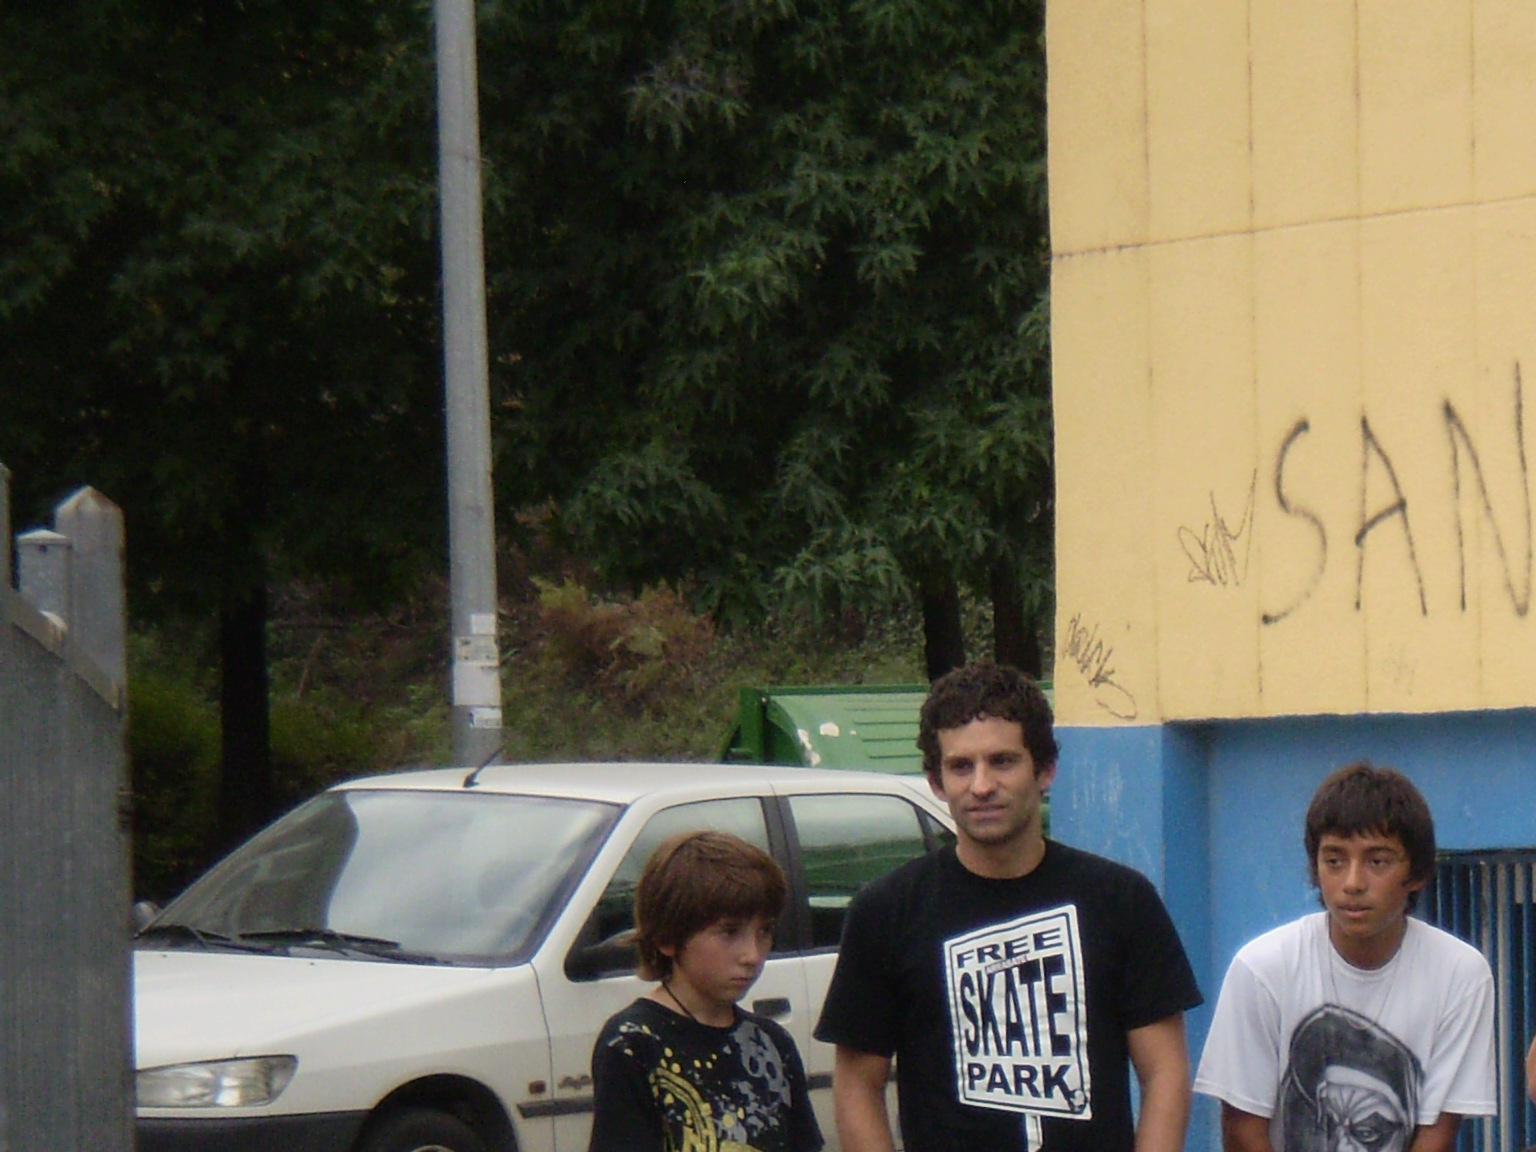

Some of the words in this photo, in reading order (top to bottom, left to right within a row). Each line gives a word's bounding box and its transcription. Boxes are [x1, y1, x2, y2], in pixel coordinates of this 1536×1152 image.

[957, 927, 1064, 968] FREE
[959, 953, 1072, 1057] SKATE
[967, 1063, 1083, 1108] PARK
